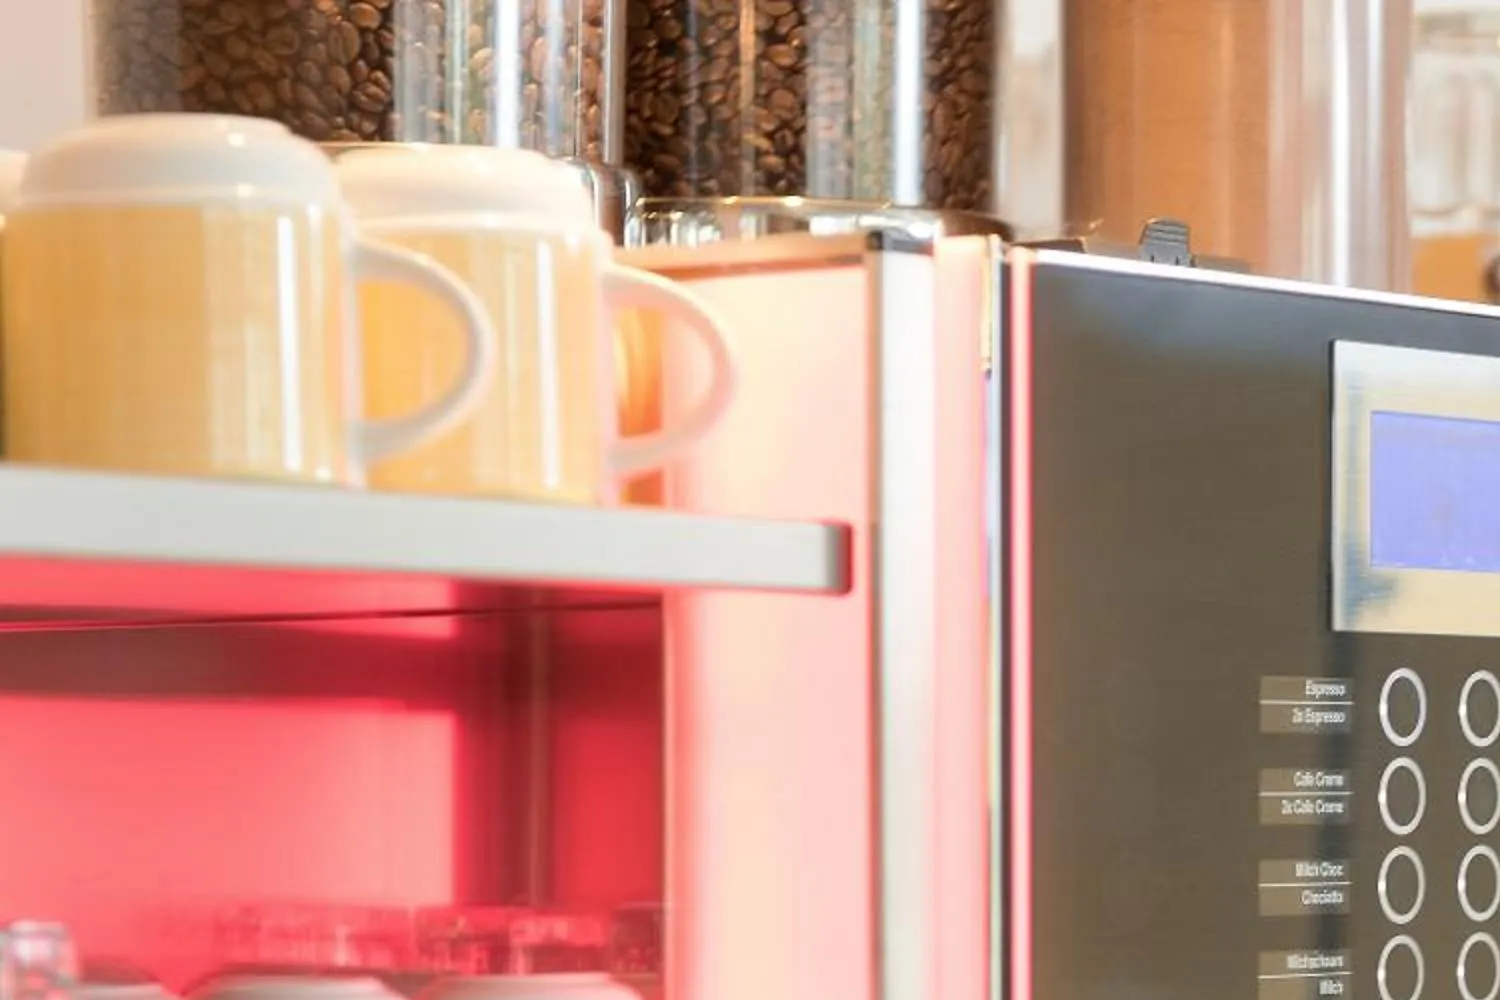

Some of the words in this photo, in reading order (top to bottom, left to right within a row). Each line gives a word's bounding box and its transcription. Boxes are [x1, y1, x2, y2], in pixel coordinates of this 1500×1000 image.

[1305, 679, 1346, 699] Espresso
[1291, 707, 1303, 723] 2x
[1304, 707, 1346, 727] Espresso
[1281, 799, 1293, 815] 2x
[1295, 861, 1318, 877] Milch
[1318, 979, 1343, 996] Milch
